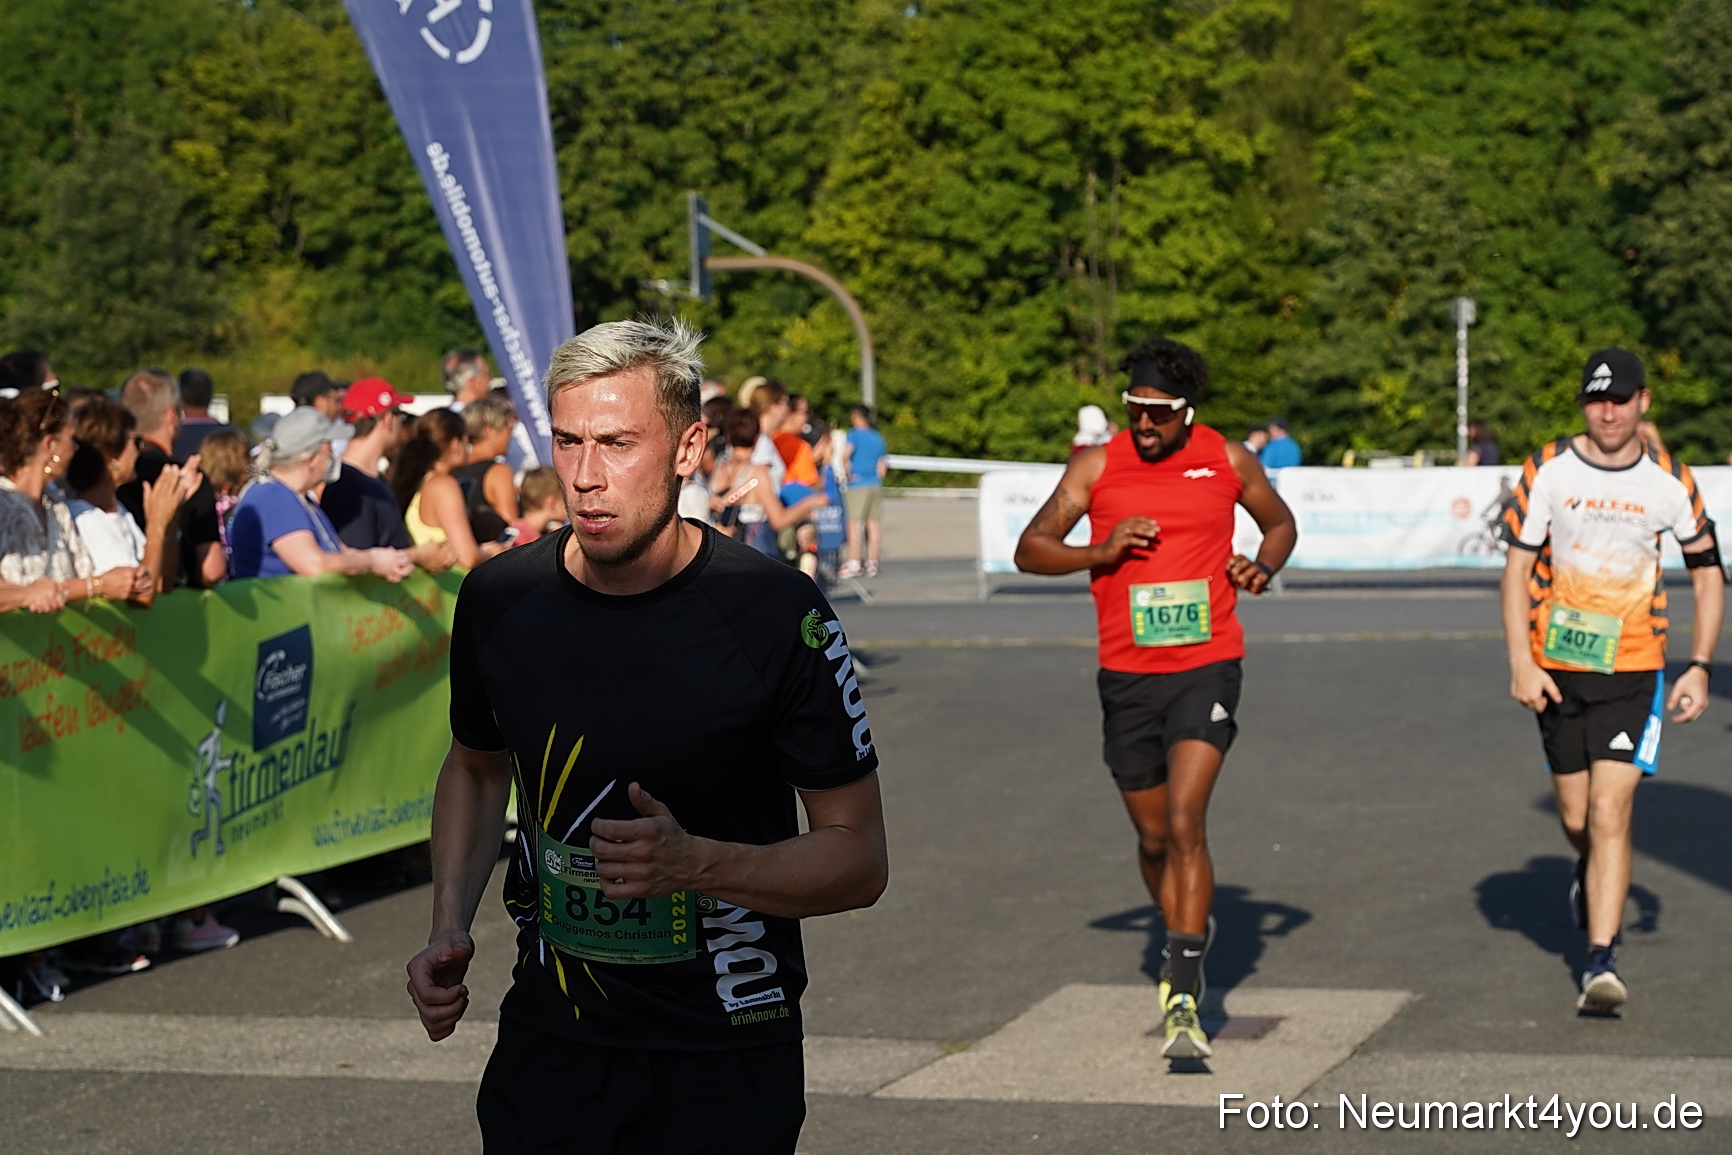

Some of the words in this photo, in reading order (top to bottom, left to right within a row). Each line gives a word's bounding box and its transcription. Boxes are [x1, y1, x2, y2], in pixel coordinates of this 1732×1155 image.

[1145, 602, 1200, 625] 1676
[1562, 628, 1600, 650] 407
[564, 867, 600, 880] Firmen
[543, 883, 553, 924] RUN
[565, 885, 651, 927] 854
[552, 915, 611, 939] Guggemos
[614, 929, 671, 940] Christian
[672, 890, 687, 945] 2022
[731, 1005, 790, 1026] drinknow.de
